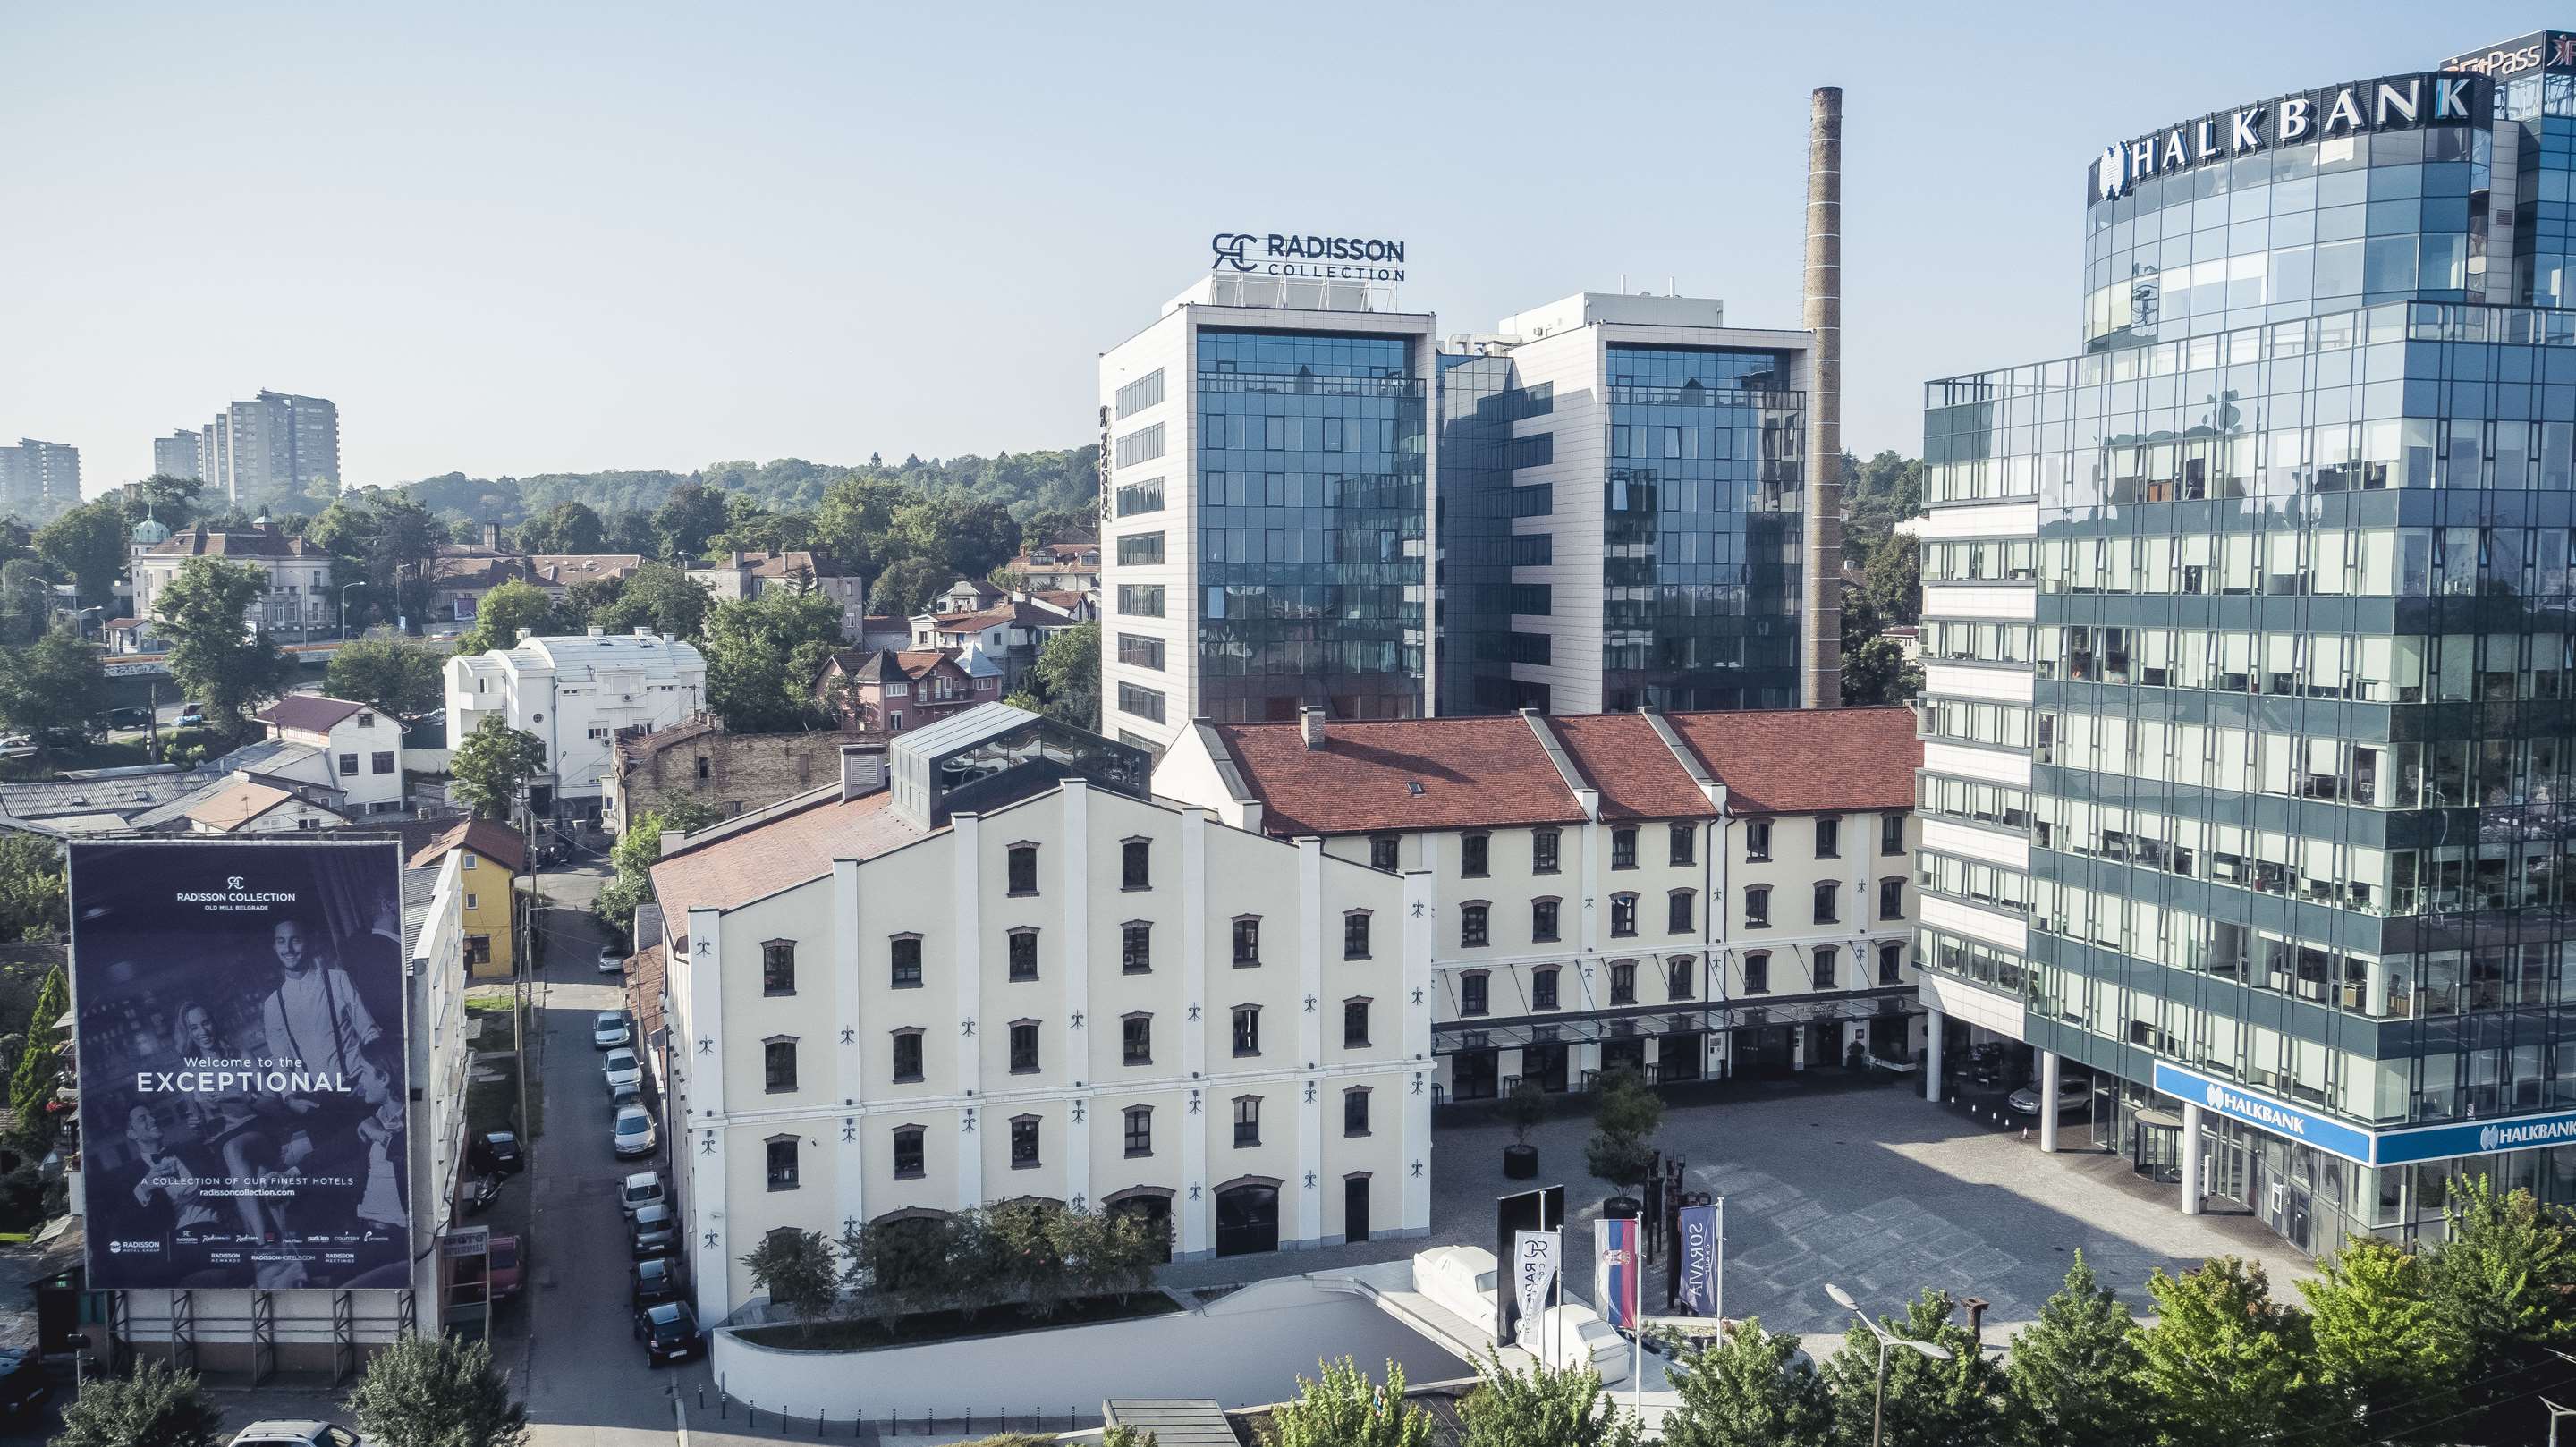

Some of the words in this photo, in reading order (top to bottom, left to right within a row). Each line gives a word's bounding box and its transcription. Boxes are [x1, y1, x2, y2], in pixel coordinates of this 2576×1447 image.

[2132, 78, 2470, 179] HALKBANK
[1268, 233, 1404, 263] RADISSON
[1268, 264, 1404, 282] COLLECTION
[177, 893, 226, 901] RADISSON
[229, 893, 296, 901] COLLECTION
[183, 1056, 251, 1068] Welcome
[258, 1057, 273, 1068] to
[279, 1056, 302, 1068] the
[137, 1072, 352, 1092] EXCEPTIONAL
[2224, 1093, 2304, 1135] HALKBANK
[2499, 1121, 2576, 1144] HALKBANK
[199, 1188, 295, 1196] radissoncollection.com
